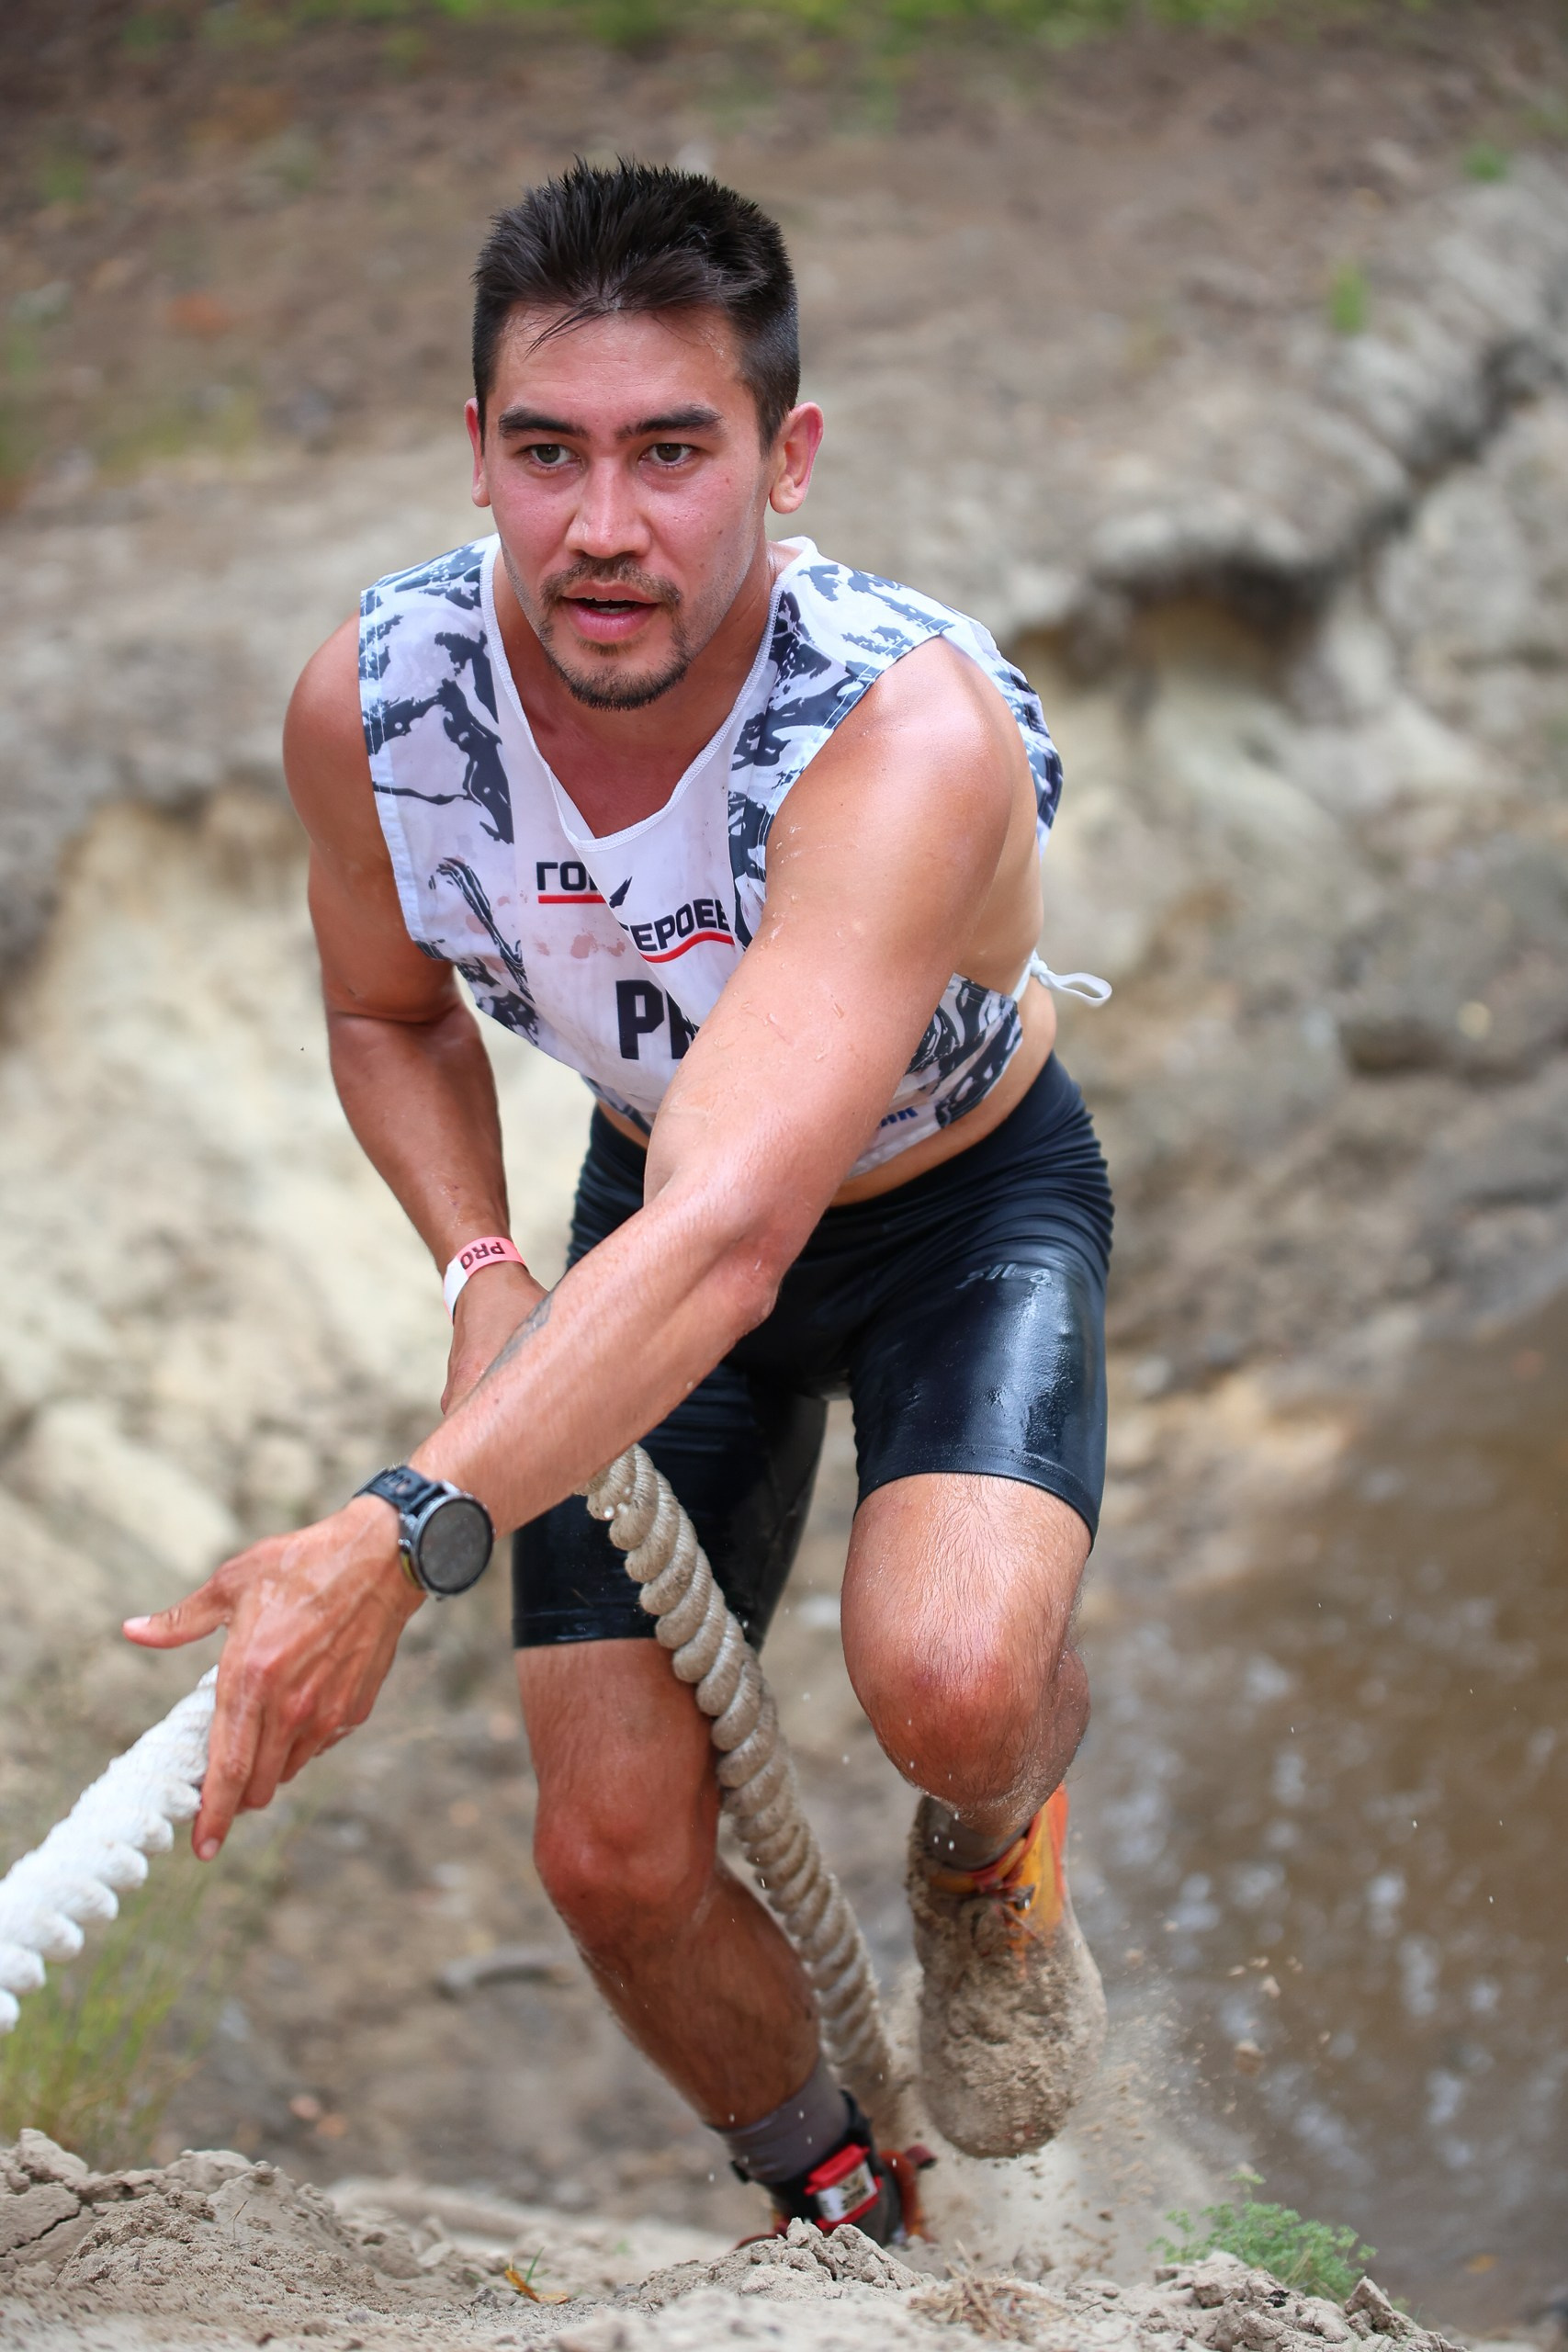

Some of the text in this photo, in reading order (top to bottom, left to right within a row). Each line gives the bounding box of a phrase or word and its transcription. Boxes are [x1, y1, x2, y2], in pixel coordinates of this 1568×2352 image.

[536, 861, 599, 891] ГО
[617, 899, 731, 952] ЕРОЕ
[460, 1241, 506, 1270] PRO
